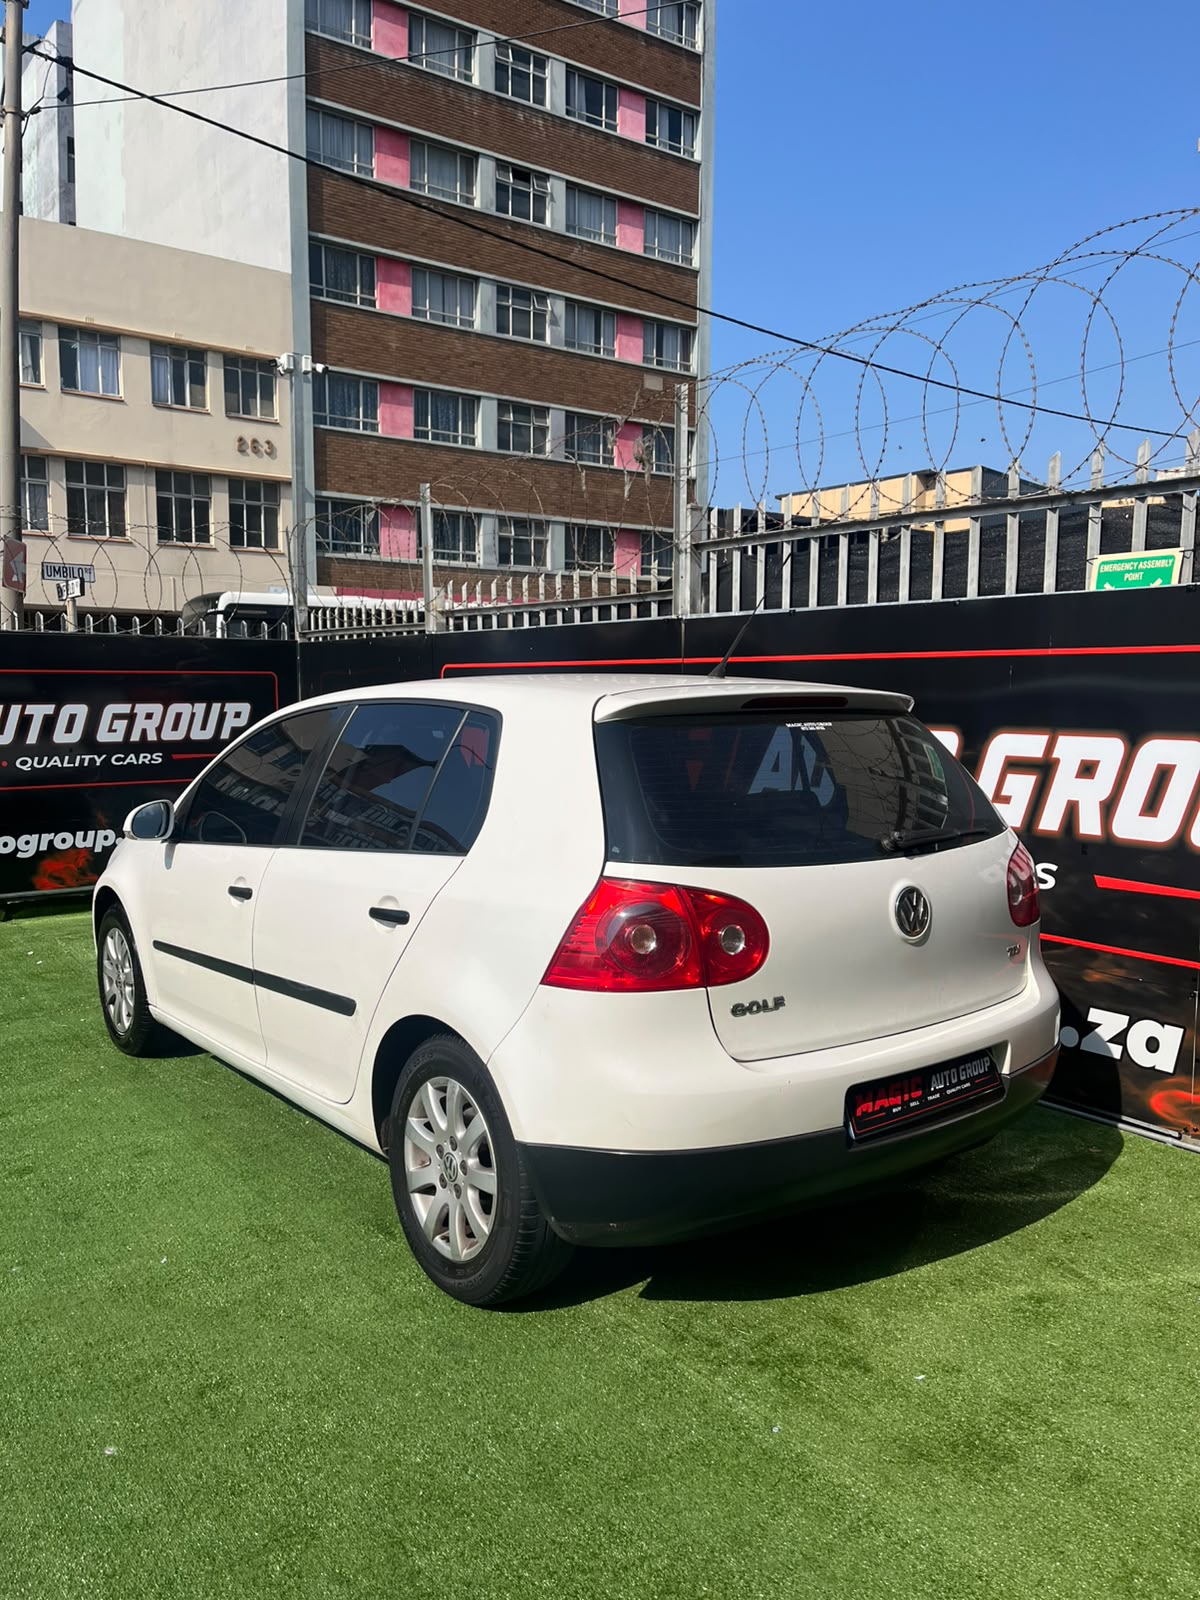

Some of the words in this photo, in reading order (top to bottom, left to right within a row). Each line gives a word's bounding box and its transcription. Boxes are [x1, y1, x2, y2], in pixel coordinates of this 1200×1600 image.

[237, 436, 275, 458] 263
[46, 565, 84, 579] UMBILO
[1100, 561, 1138, 572] EMERGENCY
[1138, 558, 1174, 569] ASSEMBLY
[1123, 571, 1144, 582] POINT
[96, 702, 251, 743] GROUP
[15, 754, 107, 771] QUALITY
[110, 752, 163, 766] CARS
[731, 995, 786, 1018] GOLF
[1060, 1007, 1184, 1074] .za
[855, 1075, 923, 1117] MAGIC
[930, 1066, 958, 1091] AUTO
[959, 1056, 991, 1081] GROUP
